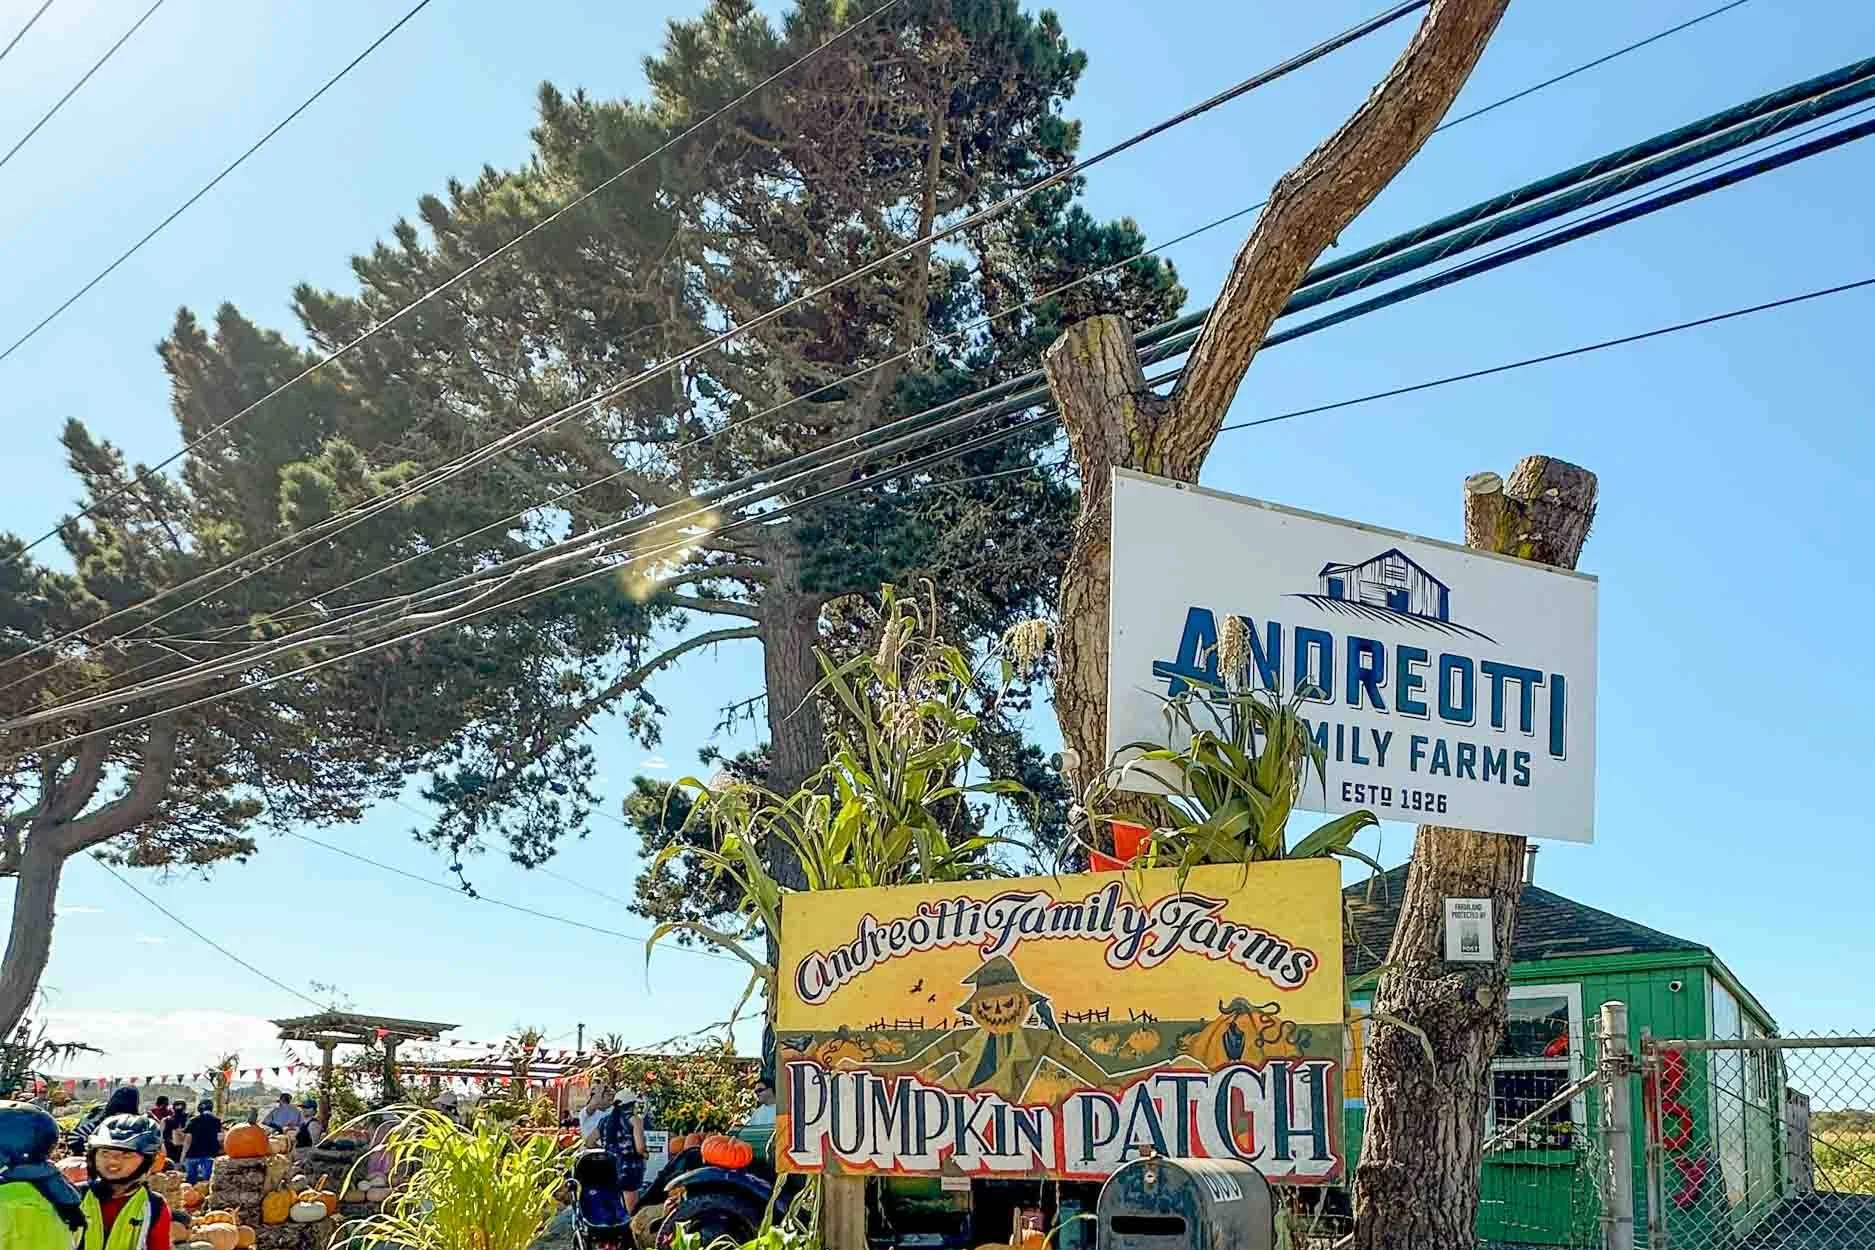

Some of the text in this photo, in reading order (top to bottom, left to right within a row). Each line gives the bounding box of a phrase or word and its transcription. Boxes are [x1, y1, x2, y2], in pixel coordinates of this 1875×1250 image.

[1153, 606, 1566, 759] ANDREOTTI
[1400, 788, 1448, 814] 1926
[1410, 734, 1531, 787] FARMS
[982, 883, 1157, 960] Family
[1147, 895, 1314, 984] Farms
[786, 1061, 1334, 1163] PUMPKIN PATCH
